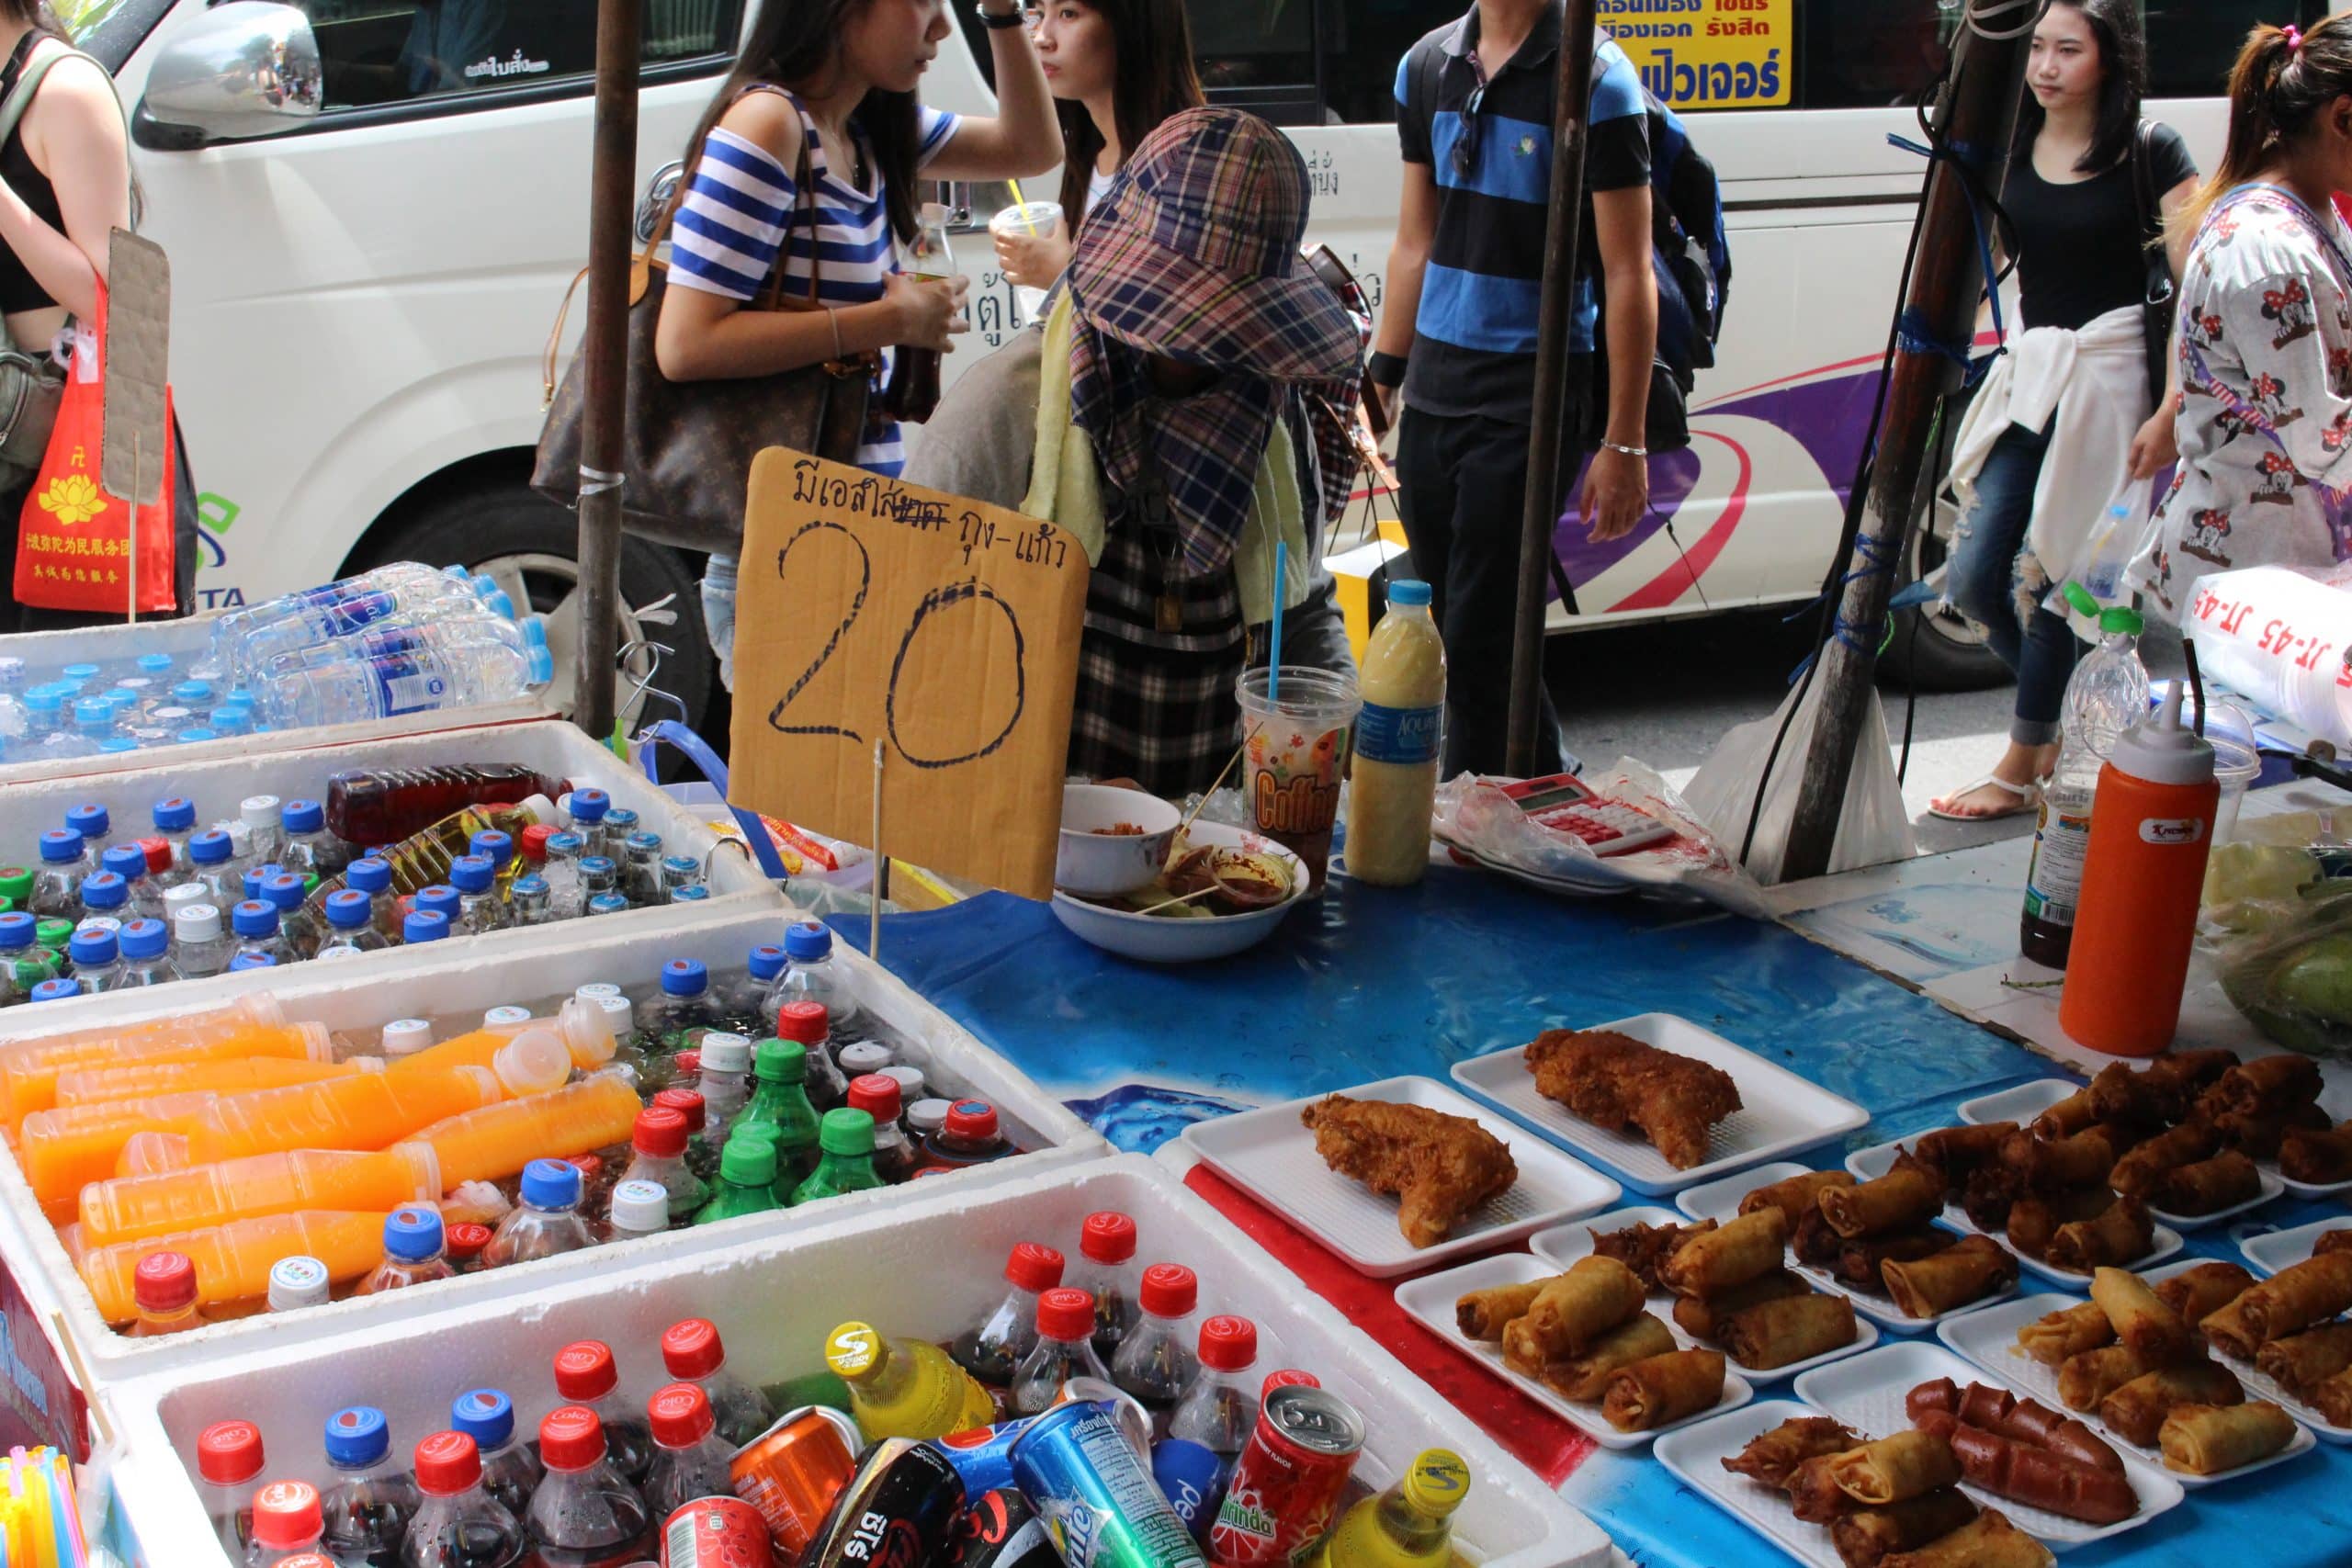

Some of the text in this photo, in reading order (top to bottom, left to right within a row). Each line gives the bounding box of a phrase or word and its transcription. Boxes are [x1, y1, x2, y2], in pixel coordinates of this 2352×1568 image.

[198, 588, 245, 609] TA
[768, 520, 1025, 770] 20
[2257, 619, 2332, 671] JT-45
[551, 1409, 592, 1421] Coke
